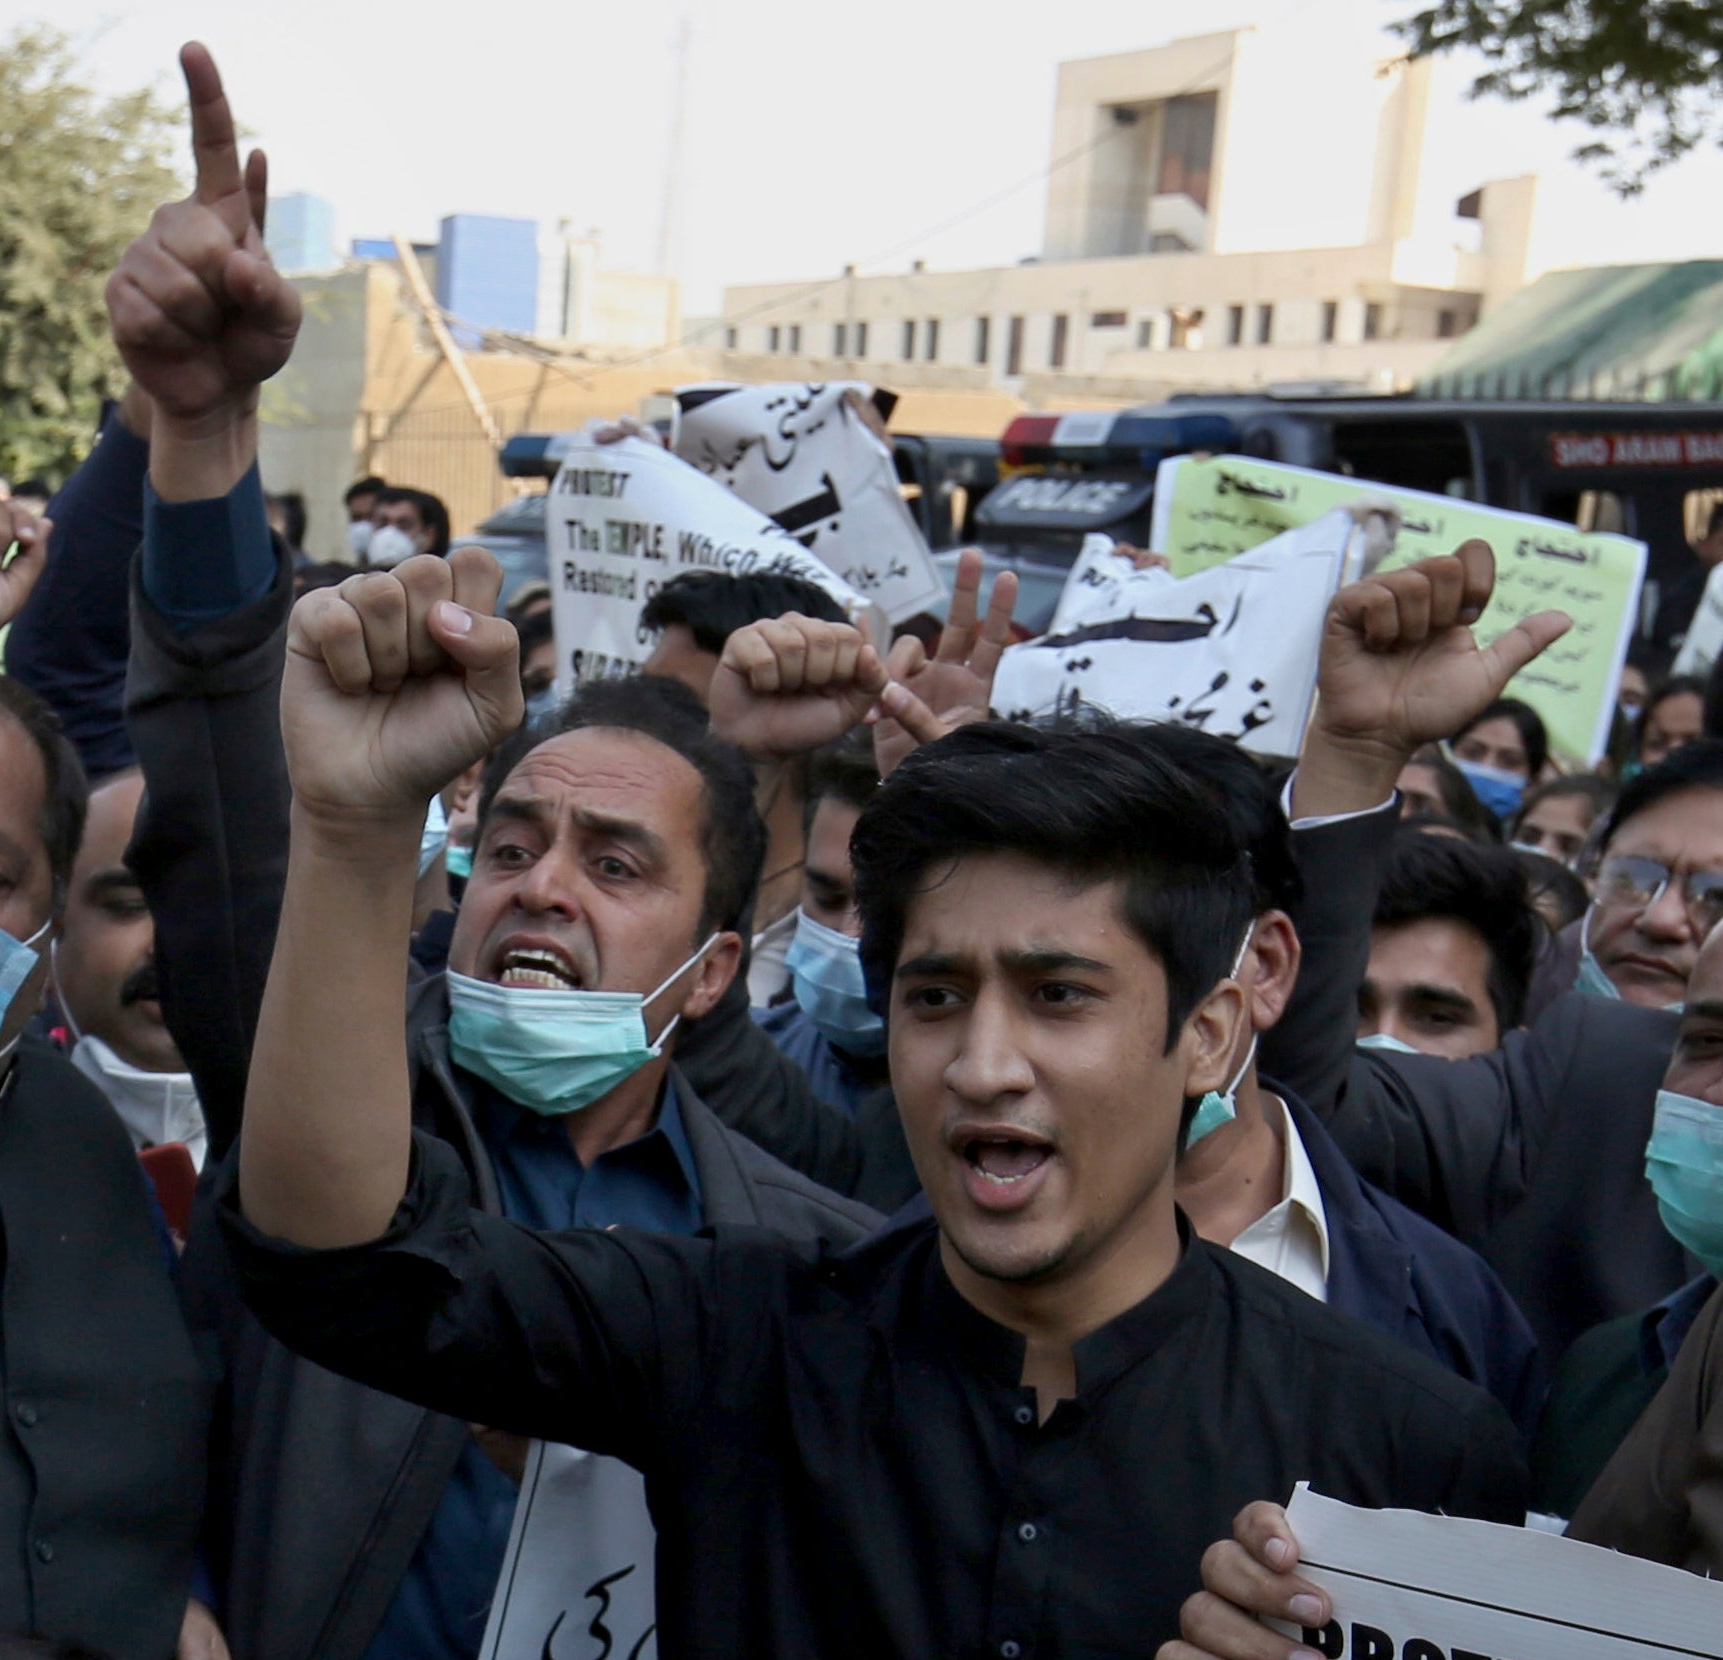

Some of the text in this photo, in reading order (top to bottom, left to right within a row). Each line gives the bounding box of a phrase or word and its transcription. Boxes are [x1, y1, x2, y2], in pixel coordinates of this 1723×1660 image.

[1613, 437, 1681, 464] ARAM
[560, 468, 631, 498] PROTEST
[995, 478, 1130, 513] POLICE
[1215, 469, 1299, 502] احتجاج
[565, 519, 600, 552] The
[1515, 538, 1602, 567] احتجاج
[563, 561, 636, 601] Restored
